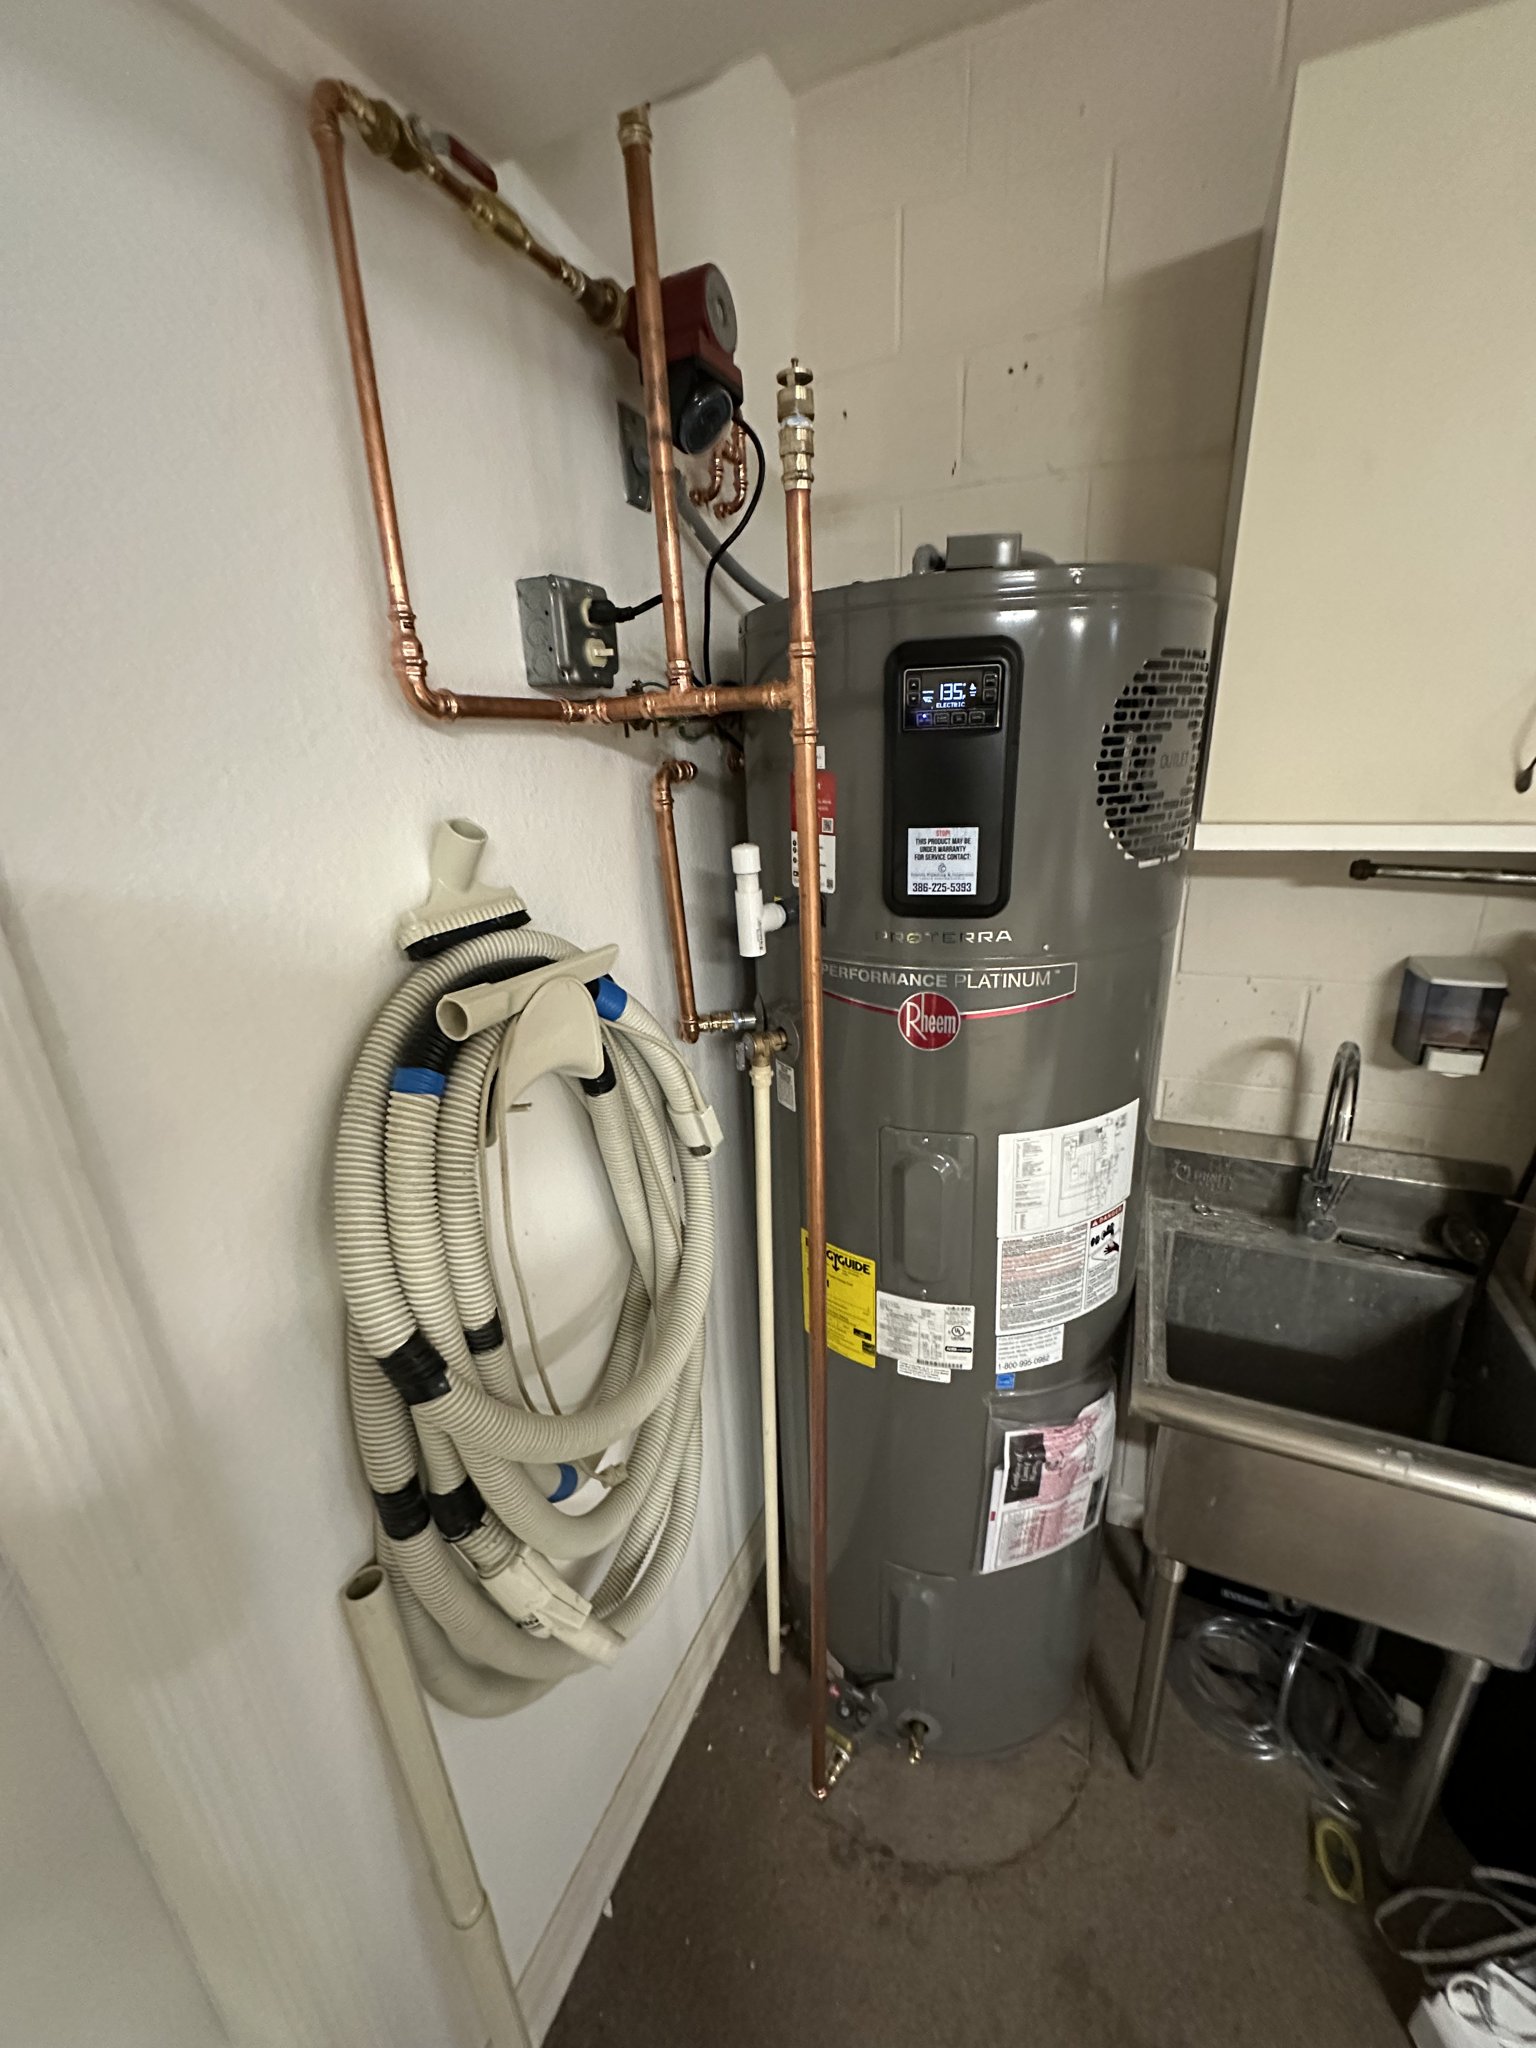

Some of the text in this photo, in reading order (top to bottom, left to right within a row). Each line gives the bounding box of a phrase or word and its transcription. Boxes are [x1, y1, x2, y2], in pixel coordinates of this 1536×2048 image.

[912, 883, 972, 892] 386-225-5393
[876, 930, 1012, 944] PROTERRA
[822, 964, 948, 988] PERFORMANCE
[905, 993, 956, 1041] Rheem
